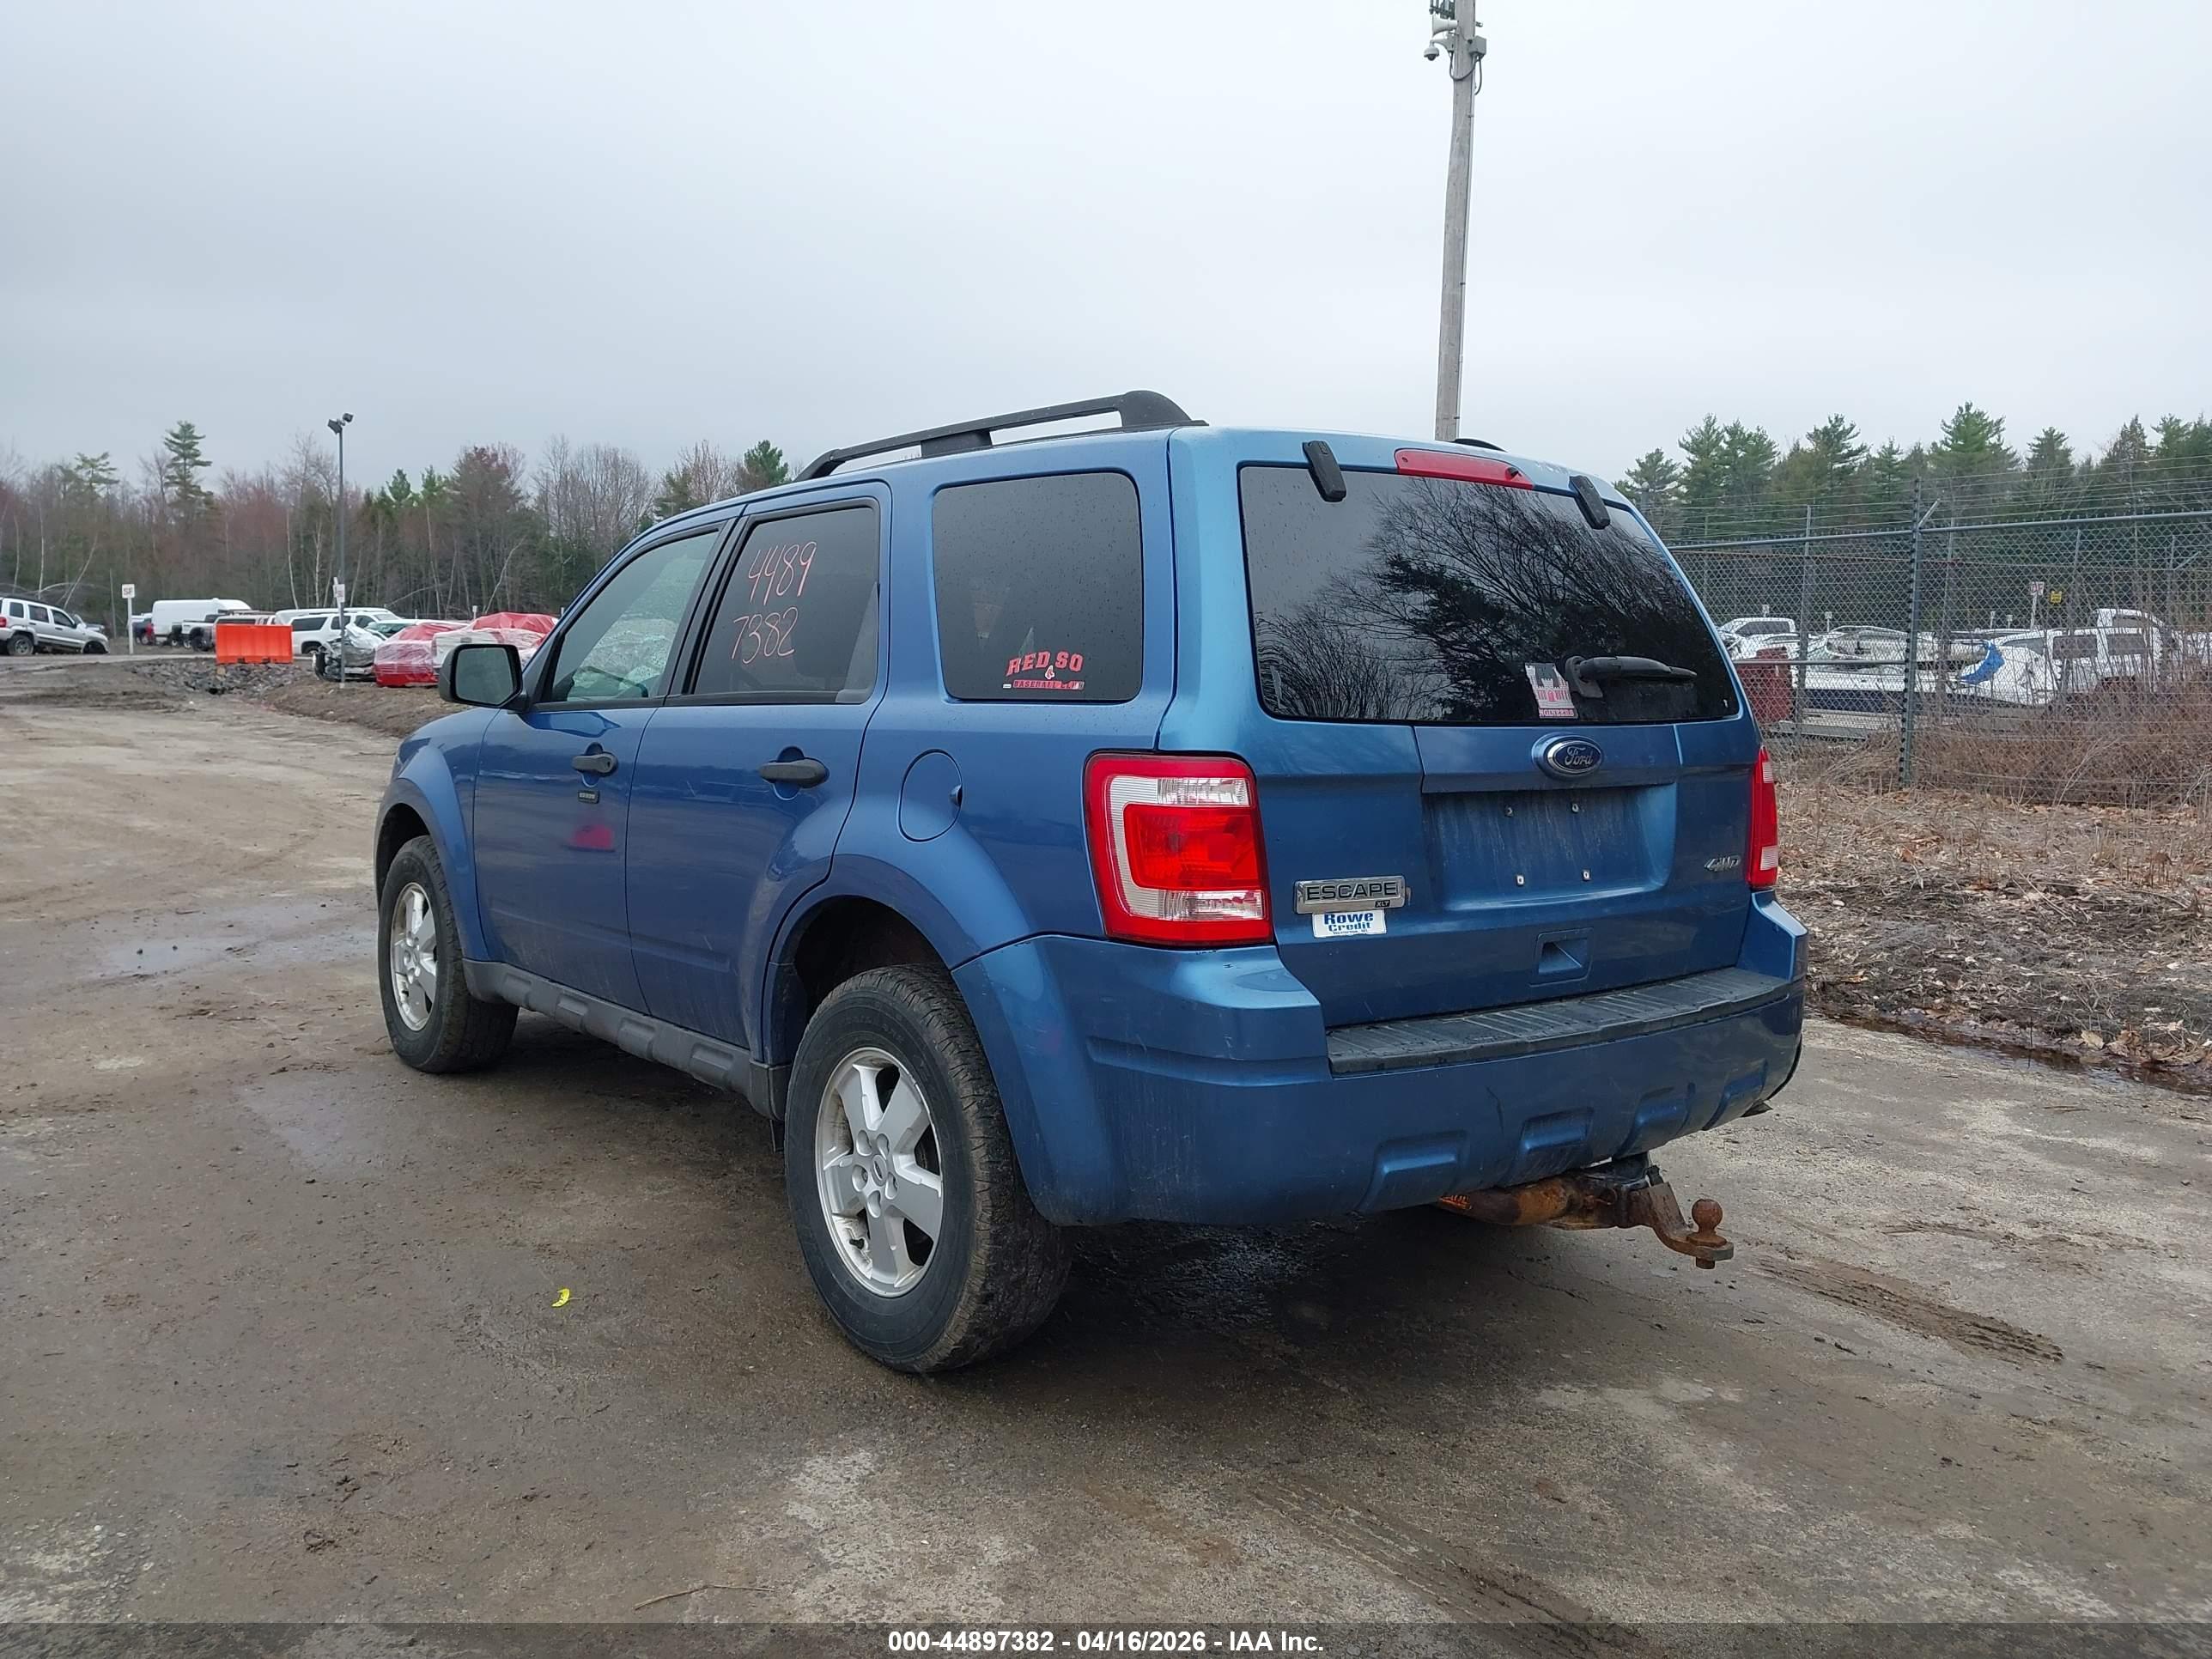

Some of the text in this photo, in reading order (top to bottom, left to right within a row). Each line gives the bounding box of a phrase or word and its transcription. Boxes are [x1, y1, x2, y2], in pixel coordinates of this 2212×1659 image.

[748, 541, 817, 605] 4489
[731, 606, 799, 664] 7382
[1006, 651, 1051, 678] RED
[1565, 745, 1595, 766] Ford
[1306, 881, 1398, 901] ESCAPE
[1323, 912, 1374, 925] Rowe
[1328, 921, 1371, 932] Credit
